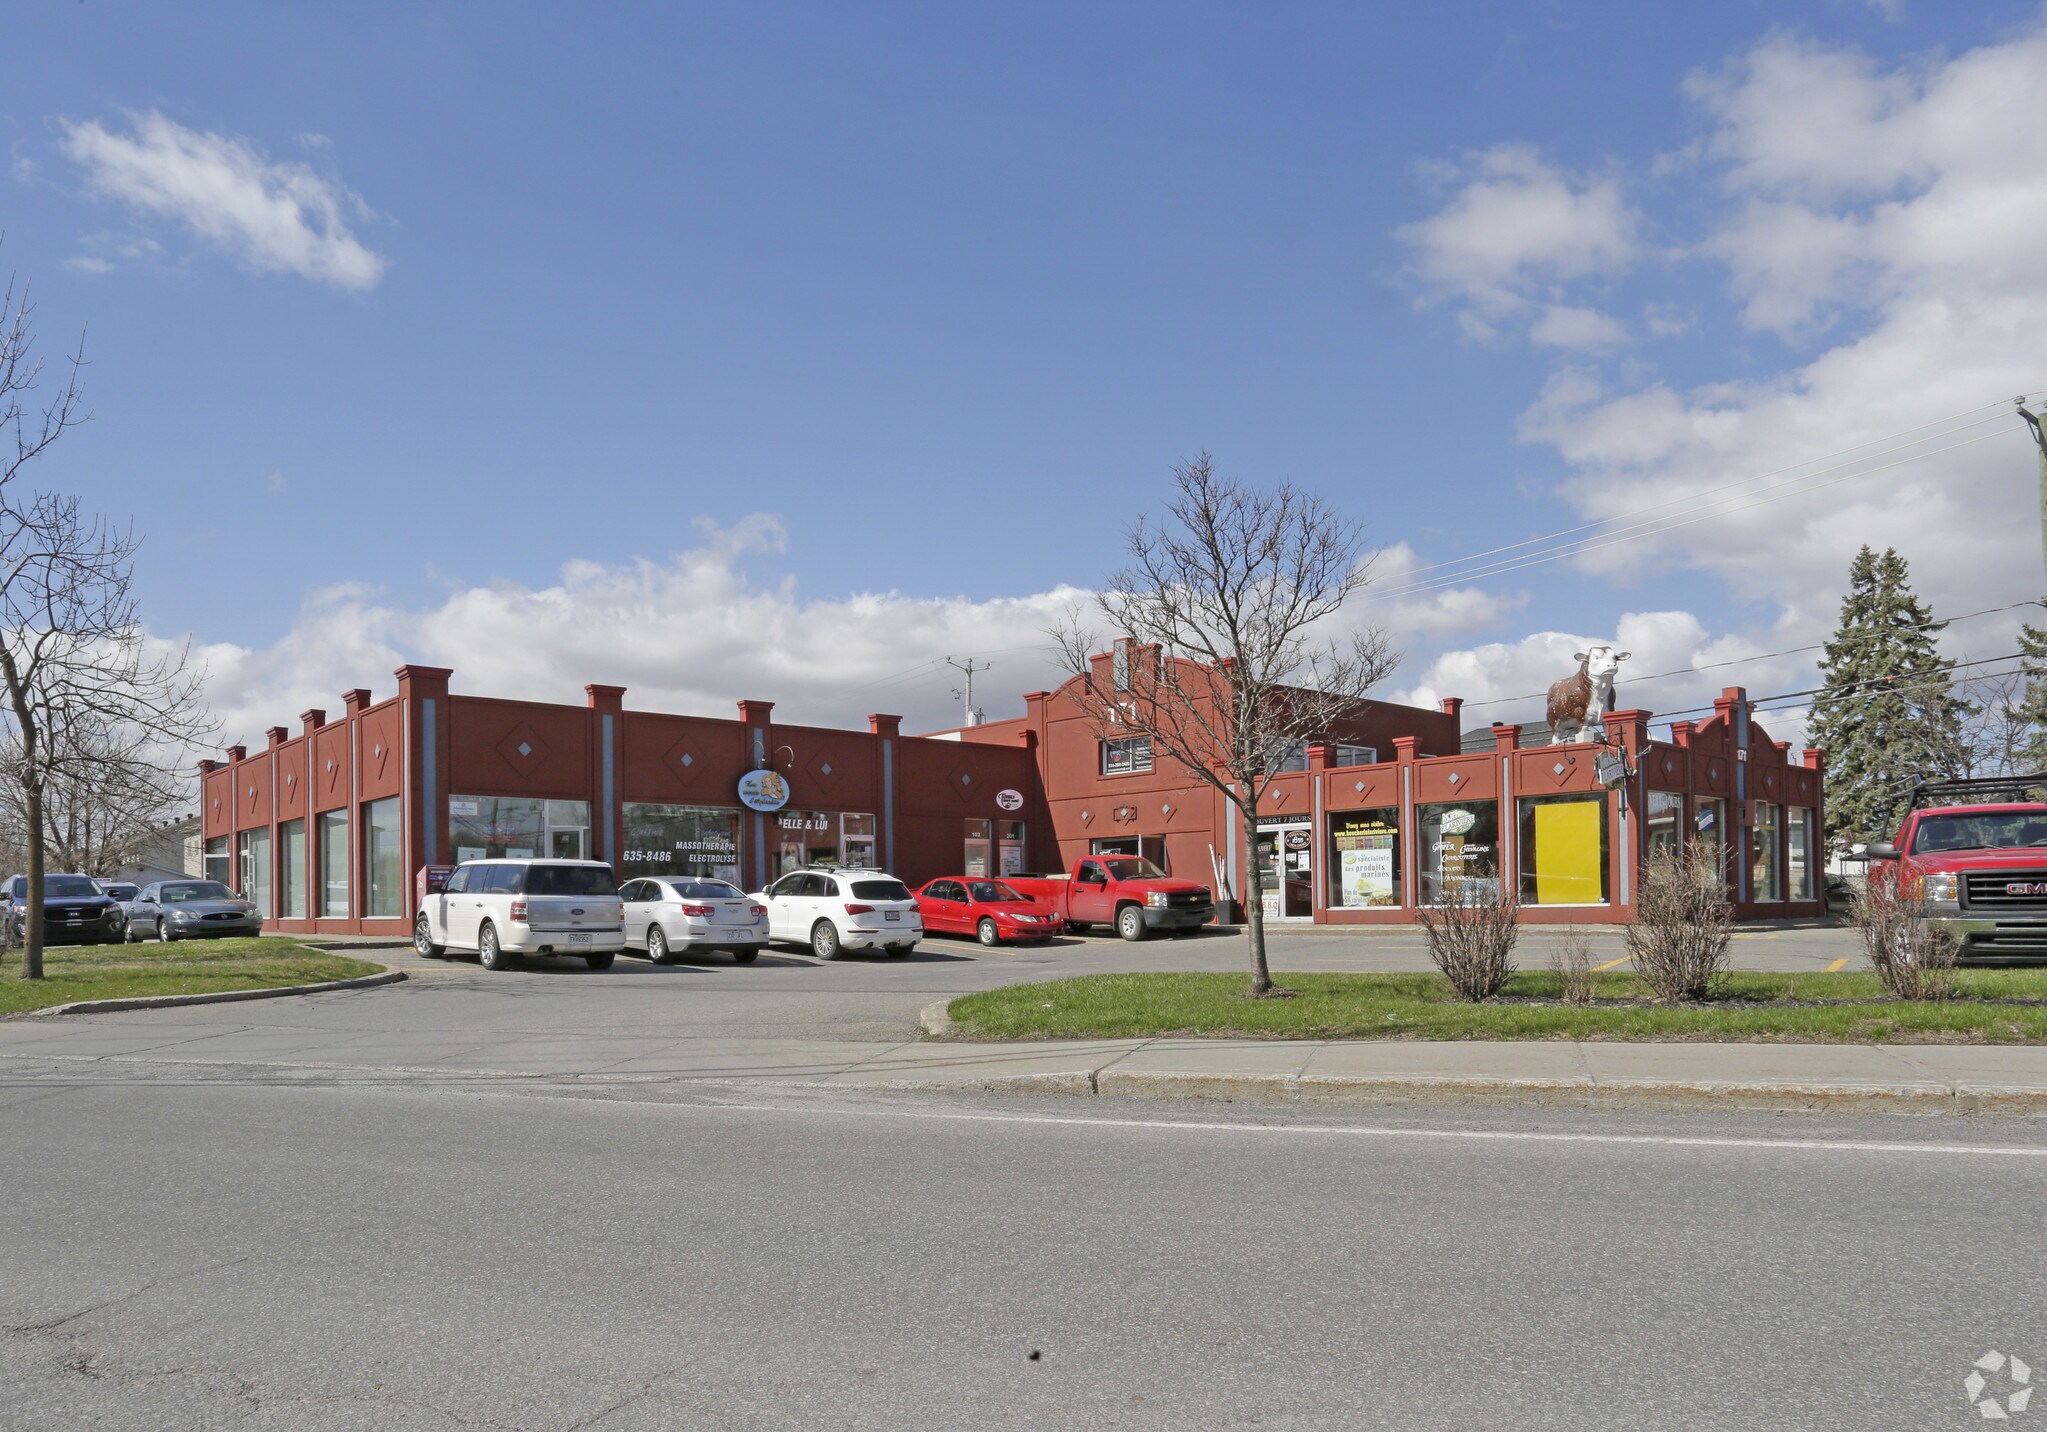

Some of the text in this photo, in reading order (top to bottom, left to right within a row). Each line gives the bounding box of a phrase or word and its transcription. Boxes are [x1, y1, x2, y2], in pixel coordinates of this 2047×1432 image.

[1737, 750, 1747, 761] 171
[1289, 815, 1311, 823] JOURS
[783, 819, 828, 830] ELLE & LUI
[675, 841, 736, 851] MASSOTHERAPIE
[623, 850, 671, 862] 635-8486
[689, 854, 736, 863] ELECTROLYSE
[1356, 864, 1385, 872] produits
[2006, 883, 2047, 894] GM
